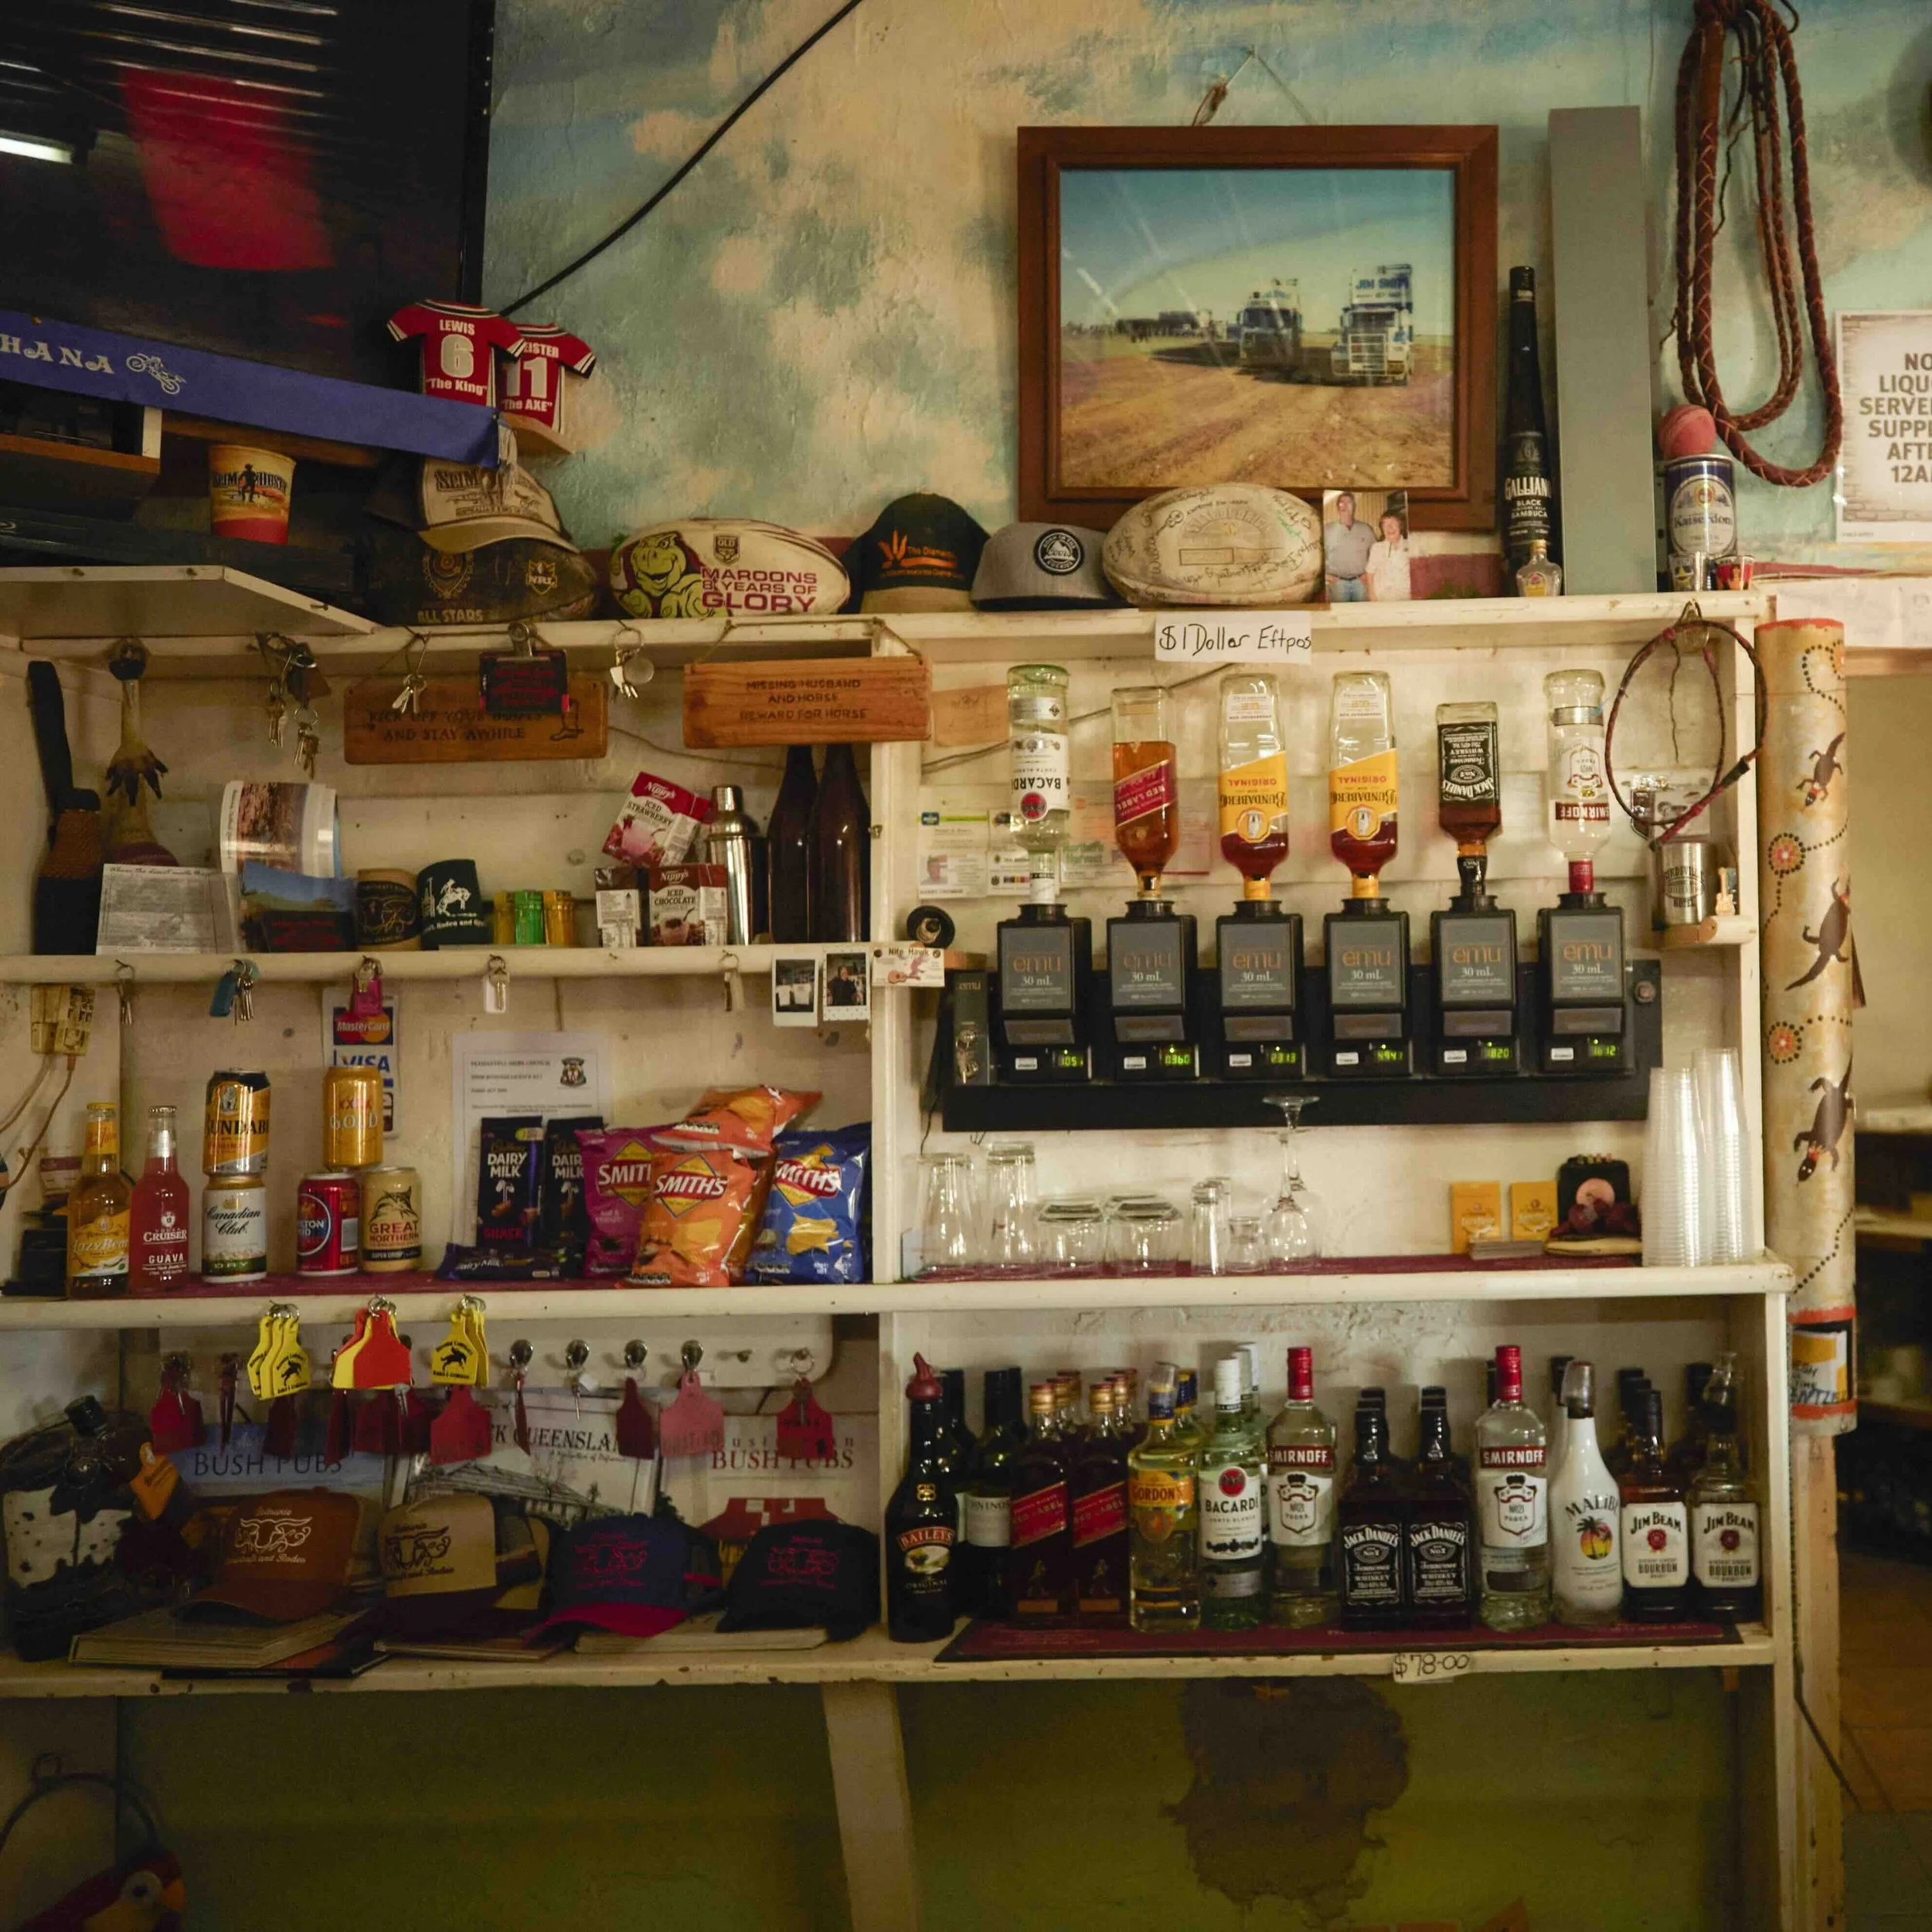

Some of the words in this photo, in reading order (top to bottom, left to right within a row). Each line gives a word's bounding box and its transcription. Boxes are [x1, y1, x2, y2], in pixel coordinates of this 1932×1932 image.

[438, 318, 476, 336] LEWIS
[440, 333, 474, 379] 6
[504, 356, 548, 400] 11
[1859, 396, 1932, 416] SERVE
[1890, 464, 1932, 483] 12A
[699, 566, 818, 585] MAROONS
[722, 580, 785, 594] YEARS
[792, 583, 818, 596] OF
[701, 590, 817, 613] GLORY
[442, 608, 484, 624] STARS
[1256, 622, 1312, 655] Eftpos
[746, 679, 797, 691] MISSING
[801, 677, 862, 690] HUSBAND
[767, 694, 795, 704] AND
[798, 692, 839, 703] HORSE
[740, 709, 793, 722] REWARD
[798, 708, 824, 720] FOR
[825, 707, 868, 719] HORSE
[626, 801, 673, 827] STRAWBERRY
[645, 800, 662, 812] ICED
[667, 889, 684, 897] ICED
[654, 897, 696, 913] CHOCOLATE
[1341, 947, 1391, 967] emu
[1452, 944, 1503, 964] emu
[1563, 942, 1613, 961] emu
[1012, 955, 1062, 972] emu
[1232, 951, 1282, 971] emu
[1131, 971, 1145, 982] 30
[1240, 971, 1255, 982] 30
[1351, 969, 1365, 981] 30
[1461, 967, 1475, 978] 30
[1572, 964, 1587, 975] 30
[1021, 975, 1036, 987] 30
[336, 1020, 391, 1033] MasterCard
[486, 1152, 528, 1167] DAIRY
[551, 1154, 583, 1167] DAIR
[489, 1164, 522, 1179] MILK
[207, 1205, 261, 1220] Canadian
[369, 1220, 418, 1235] GREAT
[142, 1229, 188, 1243] CRUISER
[369, 1233, 420, 1243] NORTHERN
[148, 1252, 184, 1264] GUAVA
[194, 1451, 264, 1478] BUSH
[712, 1450, 780, 1470] BUSH
[1269, 1449, 1330, 1465] SMIRNOFF
[1483, 1449, 1544, 1465] SMIRNOFF
[1205, 1498, 1259, 1514] BACARDI
[1630, 1515, 1651, 1535] JIM
[1652, 1511, 1682, 1533] BEAM
[1703, 1515, 1724, 1535] JIM
[1726, 1511, 1755, 1533] BEAM
[900, 1529, 954, 1548] BAILEYS
[1343, 1532, 1365, 1549] JACK
[1409, 1531, 1431, 1547] JACK
[1638, 1563, 1678, 1574] BOURBON
[1709, 1565, 1752, 1577] BOURBON
